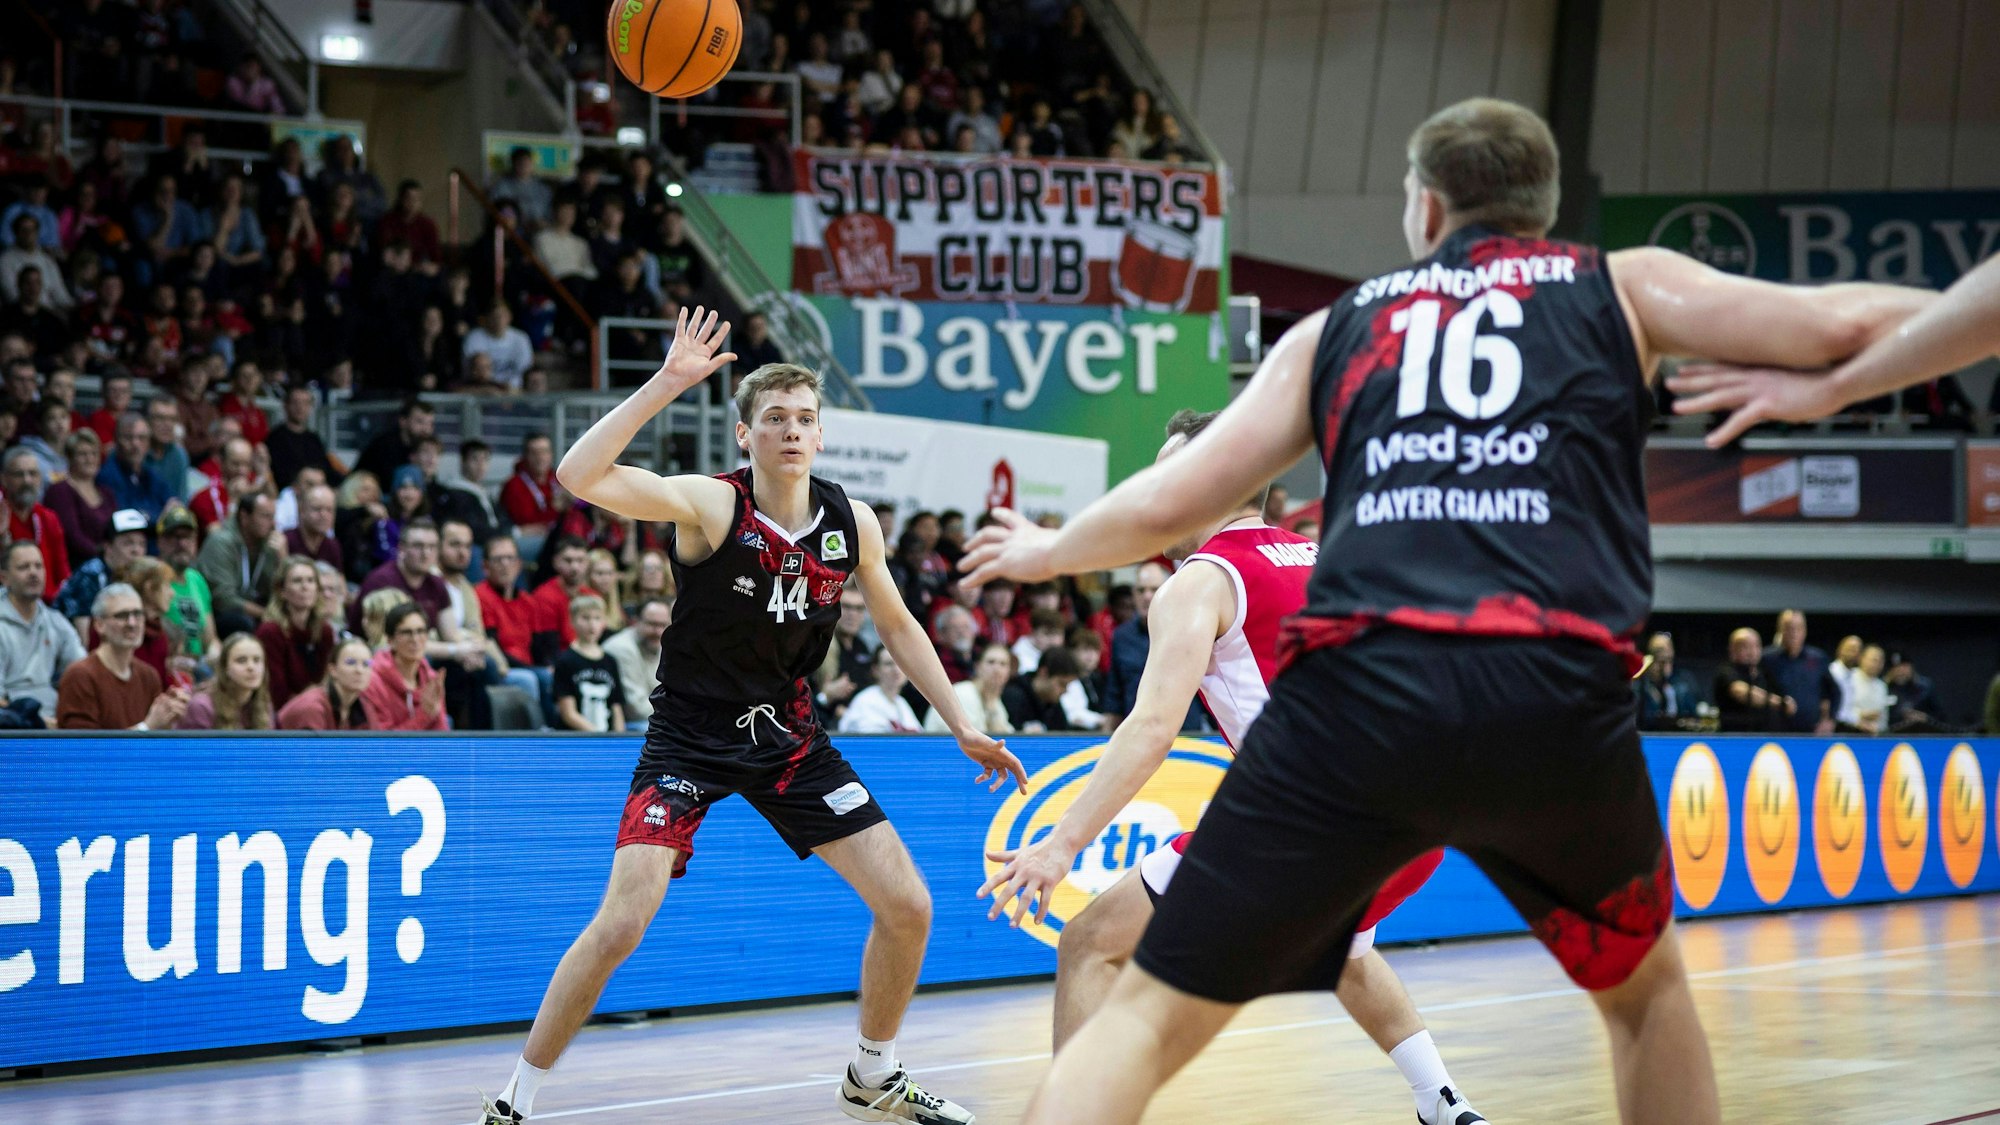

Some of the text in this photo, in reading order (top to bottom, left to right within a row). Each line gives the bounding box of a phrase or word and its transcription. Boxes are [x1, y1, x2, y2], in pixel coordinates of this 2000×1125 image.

[706, 26, 725, 56] FIBA
[815, 162, 1201, 234] SUPPORTERS
[937, 232, 1086, 297] CLUB
[1353, 254, 1576, 308] STRANGMEYER
[851, 299, 1178, 411] Bayer
[1389, 288, 1524, 421] 16
[1365, 423, 1458, 477] Med
[1356, 485, 1551, 527] BAYER GIANTS
[766, 575, 810, 624] 44
[0, 775, 447, 1025] erung?
